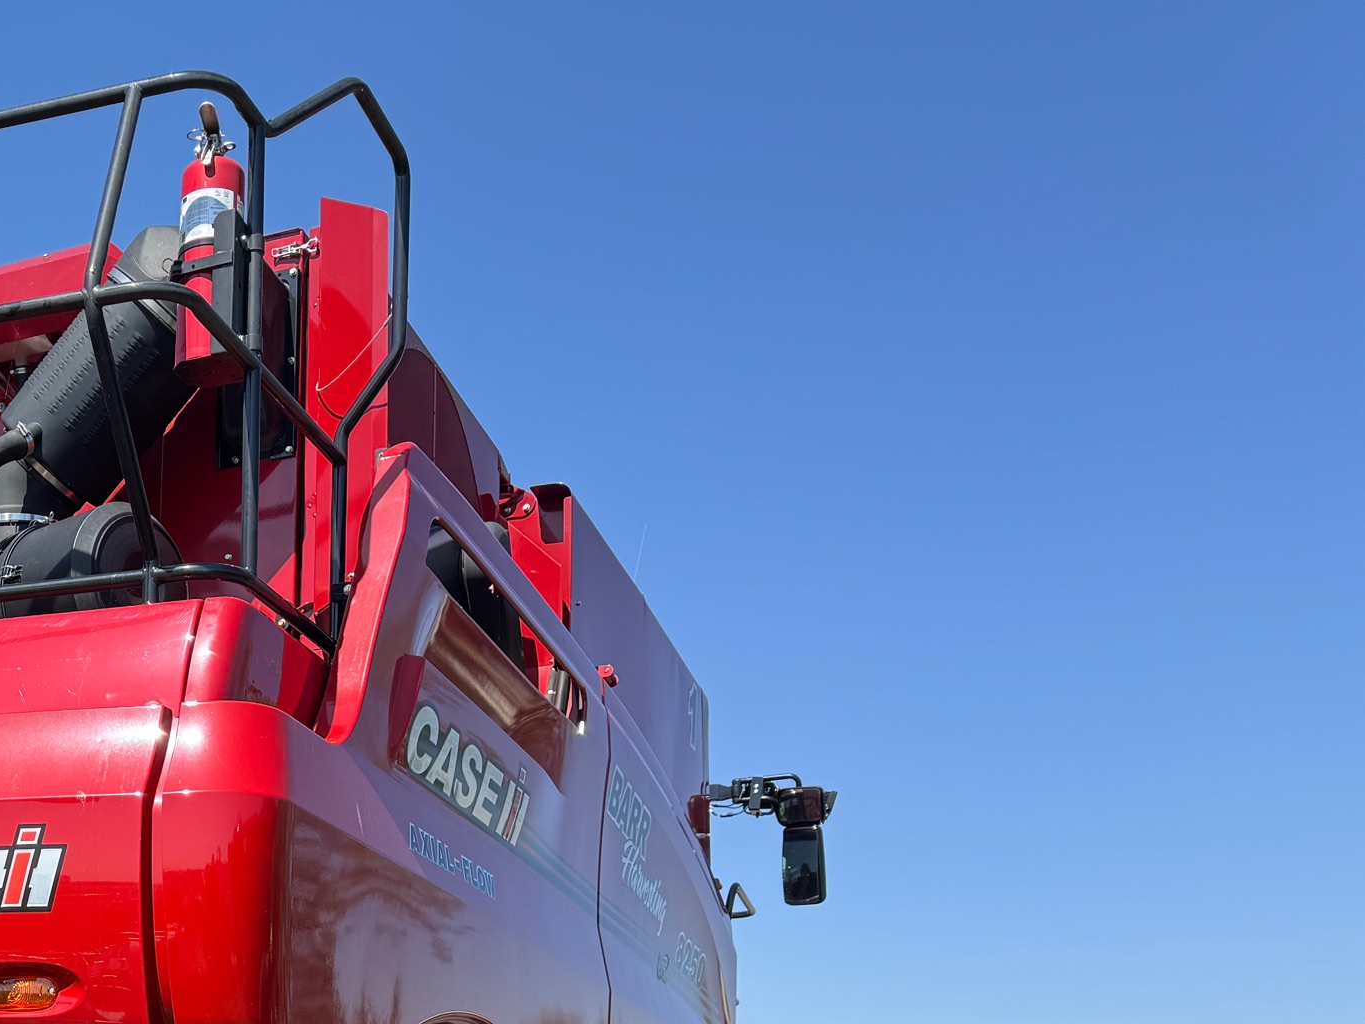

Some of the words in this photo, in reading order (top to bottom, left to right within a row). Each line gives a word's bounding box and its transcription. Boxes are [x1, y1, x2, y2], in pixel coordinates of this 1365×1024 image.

[405, 704, 505, 827] CASE
[606, 764, 652, 862] BARR
[408, 822, 497, 900] AXIAL-FLOW
[621, 838, 668, 937] Harvesting
[675, 931, 707, 988] 8250
